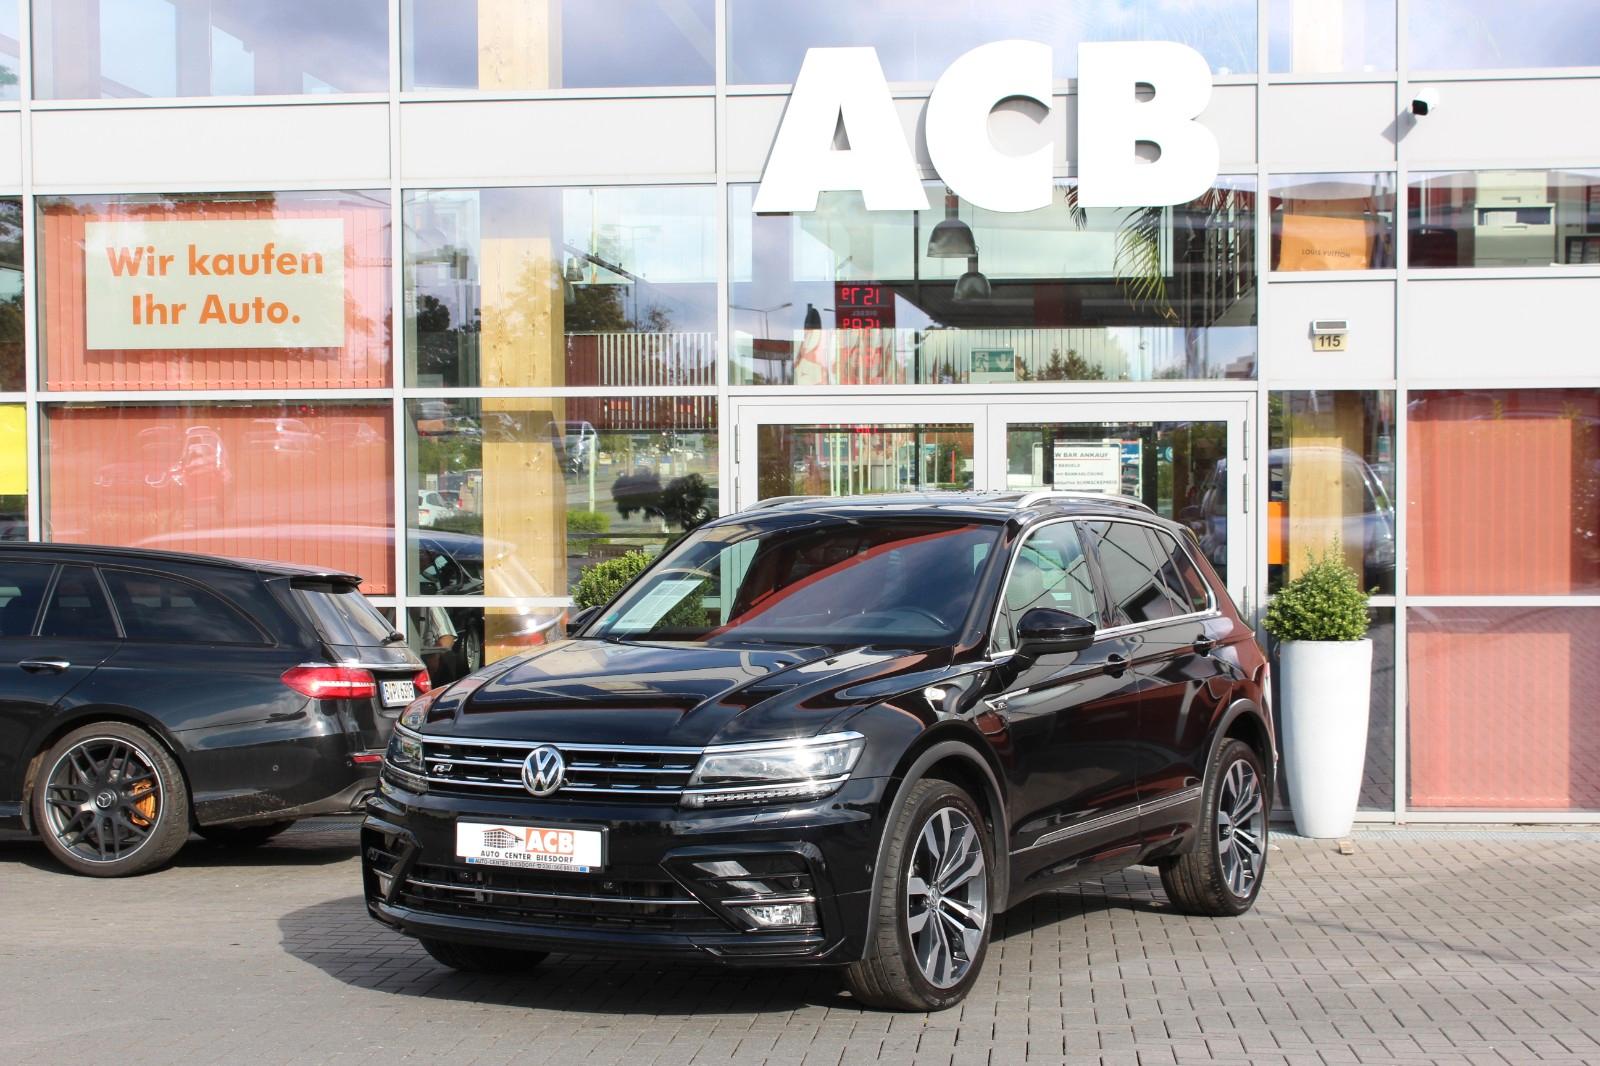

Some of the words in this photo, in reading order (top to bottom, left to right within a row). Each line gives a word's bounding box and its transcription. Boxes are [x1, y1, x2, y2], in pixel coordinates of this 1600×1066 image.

[752, 39, 1220, 213] ACB
[106, 246, 174, 276] Wir
[188, 243, 323, 276] kaufen
[1301, 248, 1320, 256] LOUIS
[132, 294, 187, 325] Ihr
[198, 294, 301, 325] Auto.
[1318, 335, 1341, 347] 115
[526, 828, 574, 854] ACB
[480, 850, 500, 858] AUTO
[504, 852, 532, 861] CENTER
[536, 854, 574, 863] BIESDORF
